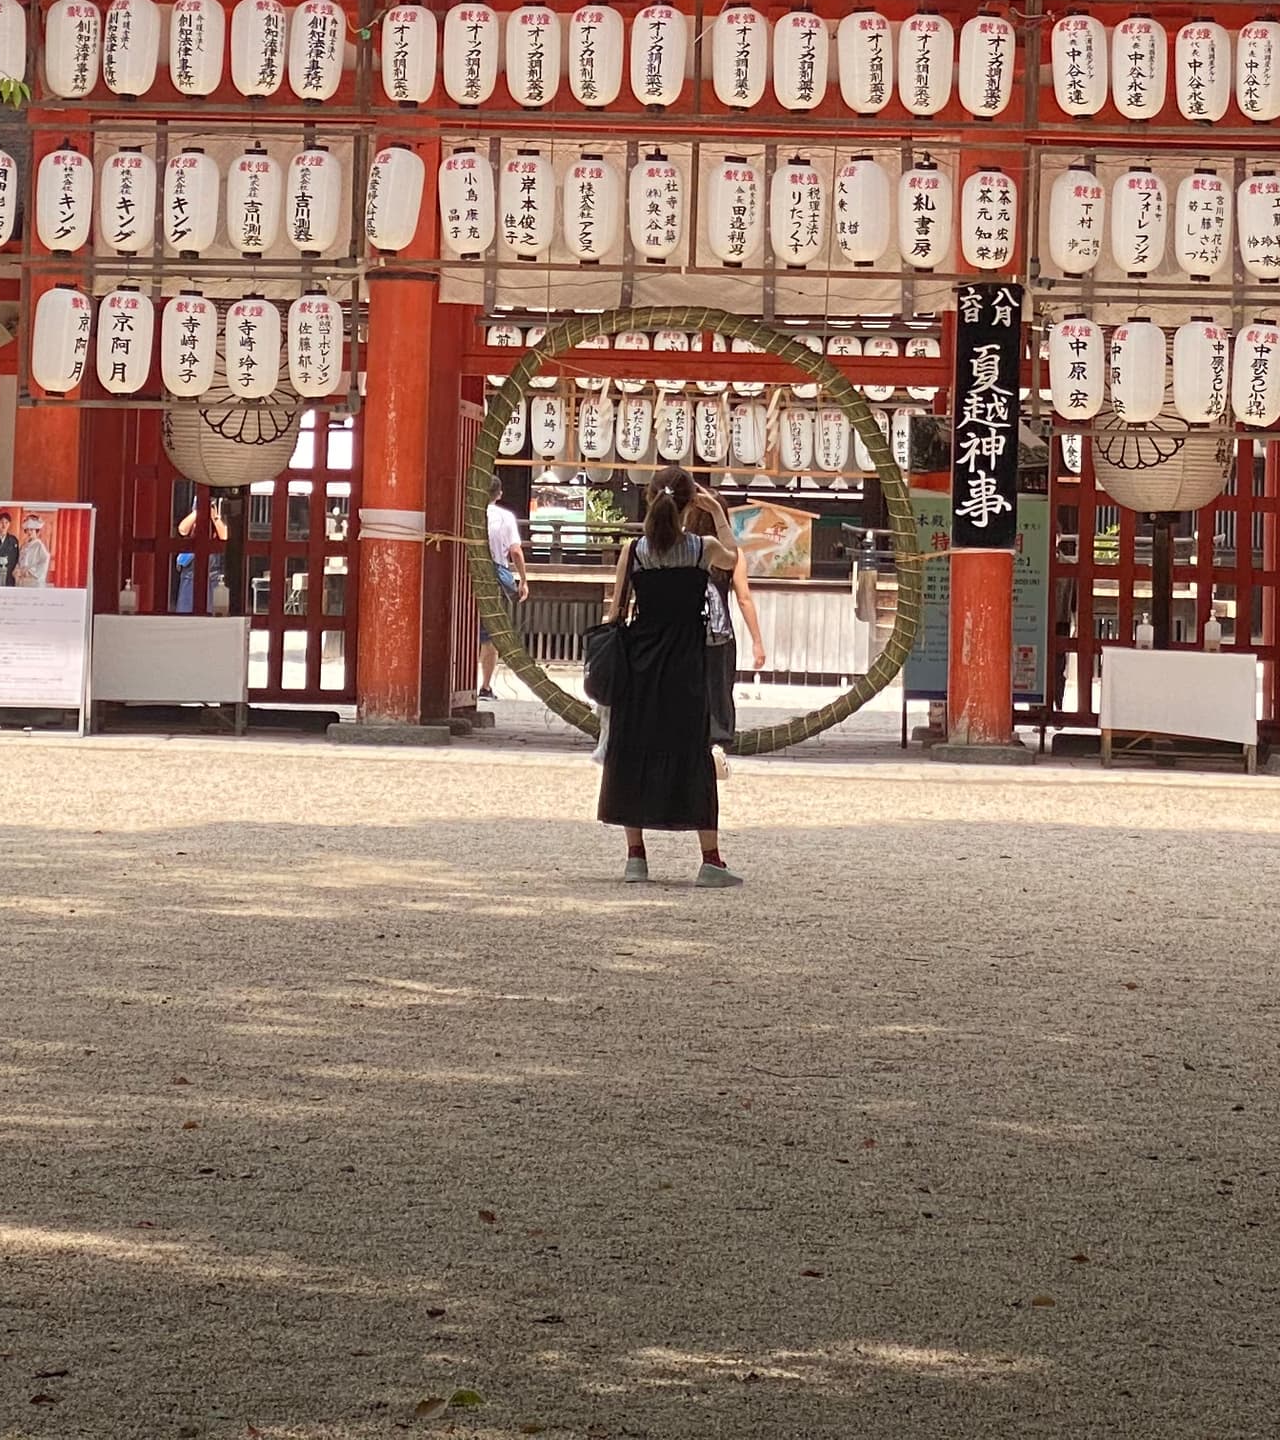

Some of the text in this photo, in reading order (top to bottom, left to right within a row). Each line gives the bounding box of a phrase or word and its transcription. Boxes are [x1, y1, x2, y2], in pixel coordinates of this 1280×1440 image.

[71, 20, 91, 91] 創知法律事務所
[106, 12, 118, 86] 創知法律事務所
[120, 11, 131, 50] 弁護士法人
[177, 14, 193, 87] 創知法律事務所
[195, 16, 204, 52] 弁護士法人
[256, 15, 279, 89] 創知法律事務所
[303, 16, 325, 91] 創知法律事務所
[326, 18, 338, 61] 弁護士法人
[392, 25, 409, 97] オーツカ調剤薬局
[463, 24, 482, 98] オーツカ調剤薬局
[526, 27, 545, 101] オーツカ調剤薬局
[580, 26, 598, 100] オーツカ調剤薬局
[646, 22, 666, 96] オーツカ調剤薬局
[734, 26, 752, 99] オーツカ調剤薬局
[797, 30, 817, 101] オーツカ調剤薬局
[866, 34, 885, 103] オーツカ調剤薬局
[913, 34, 931, 107] オーツカ調剤薬局
[983, 36, 1005, 109] オーツカ調剤薬局
[448, 209, 462, 239] 晶子
[505, 214, 519, 244] 佳子
[518, 176, 538, 246] 岸本俊之
[579, 182, 596, 252] 株式会社アクロス
[664, 179, 679, 243] 社寺建築
[789, 191, 807, 254] りたっくす
[805, 186, 821, 246] 税理士法人
[976, 189, 993, 261] 茶元知栄
[993, 189, 1011, 263] 茶元宏樹
[1079, 203, 1093, 229] 下村
[959, 288, 984, 324] 六日
[991, 288, 1019, 328] 八月
[110, 312, 133, 383] 京阿月
[298, 322, 312, 383] 佐藤郁子
[1068, 339, 1089, 408] 中原宏
[1245, 344, 1272, 419] 中原ひろし小児科
[955, 344, 1014, 528] 夏越神事
